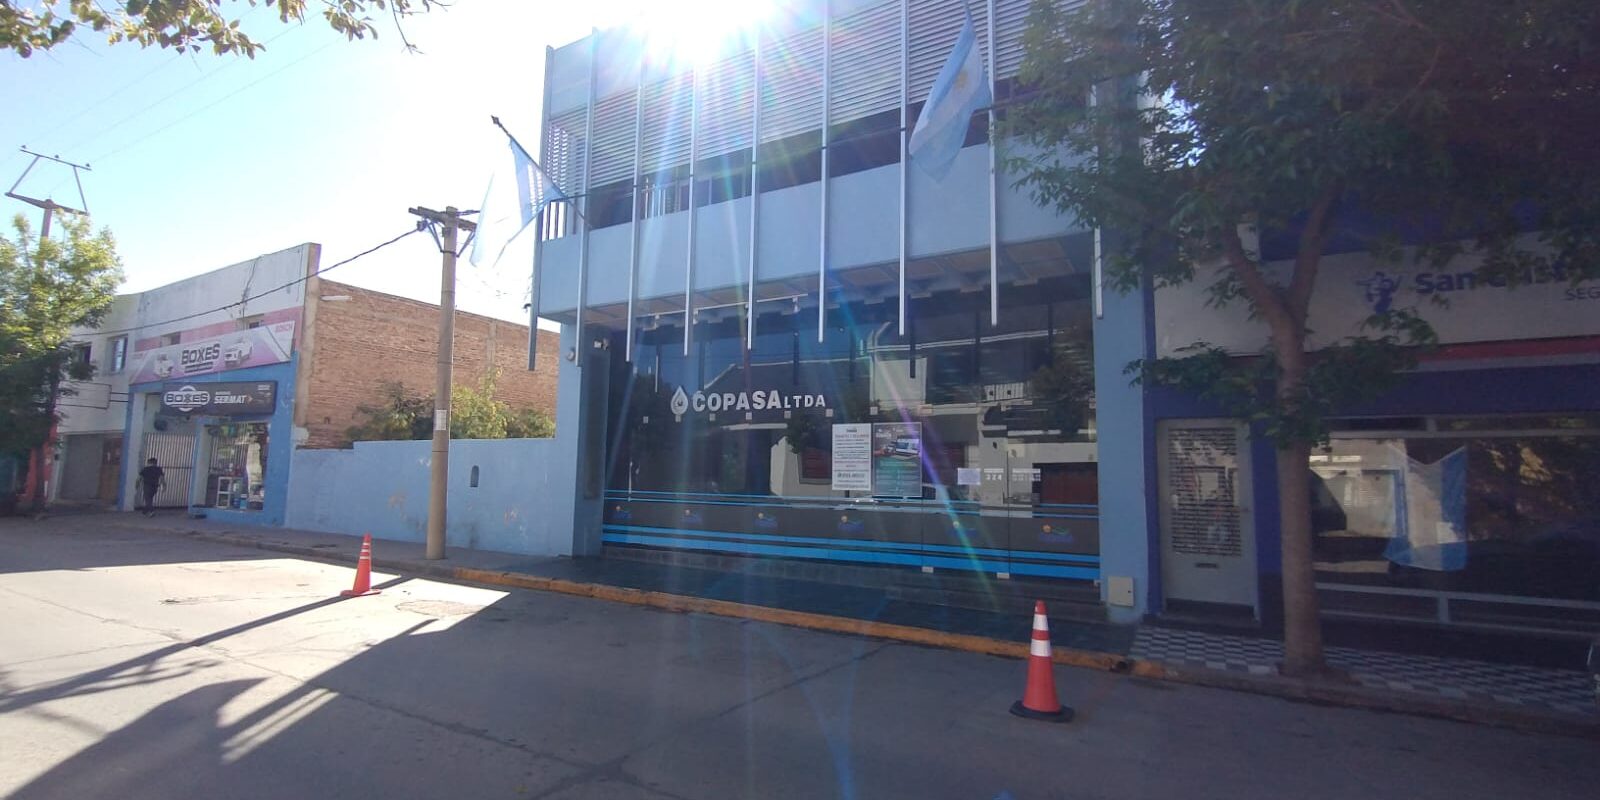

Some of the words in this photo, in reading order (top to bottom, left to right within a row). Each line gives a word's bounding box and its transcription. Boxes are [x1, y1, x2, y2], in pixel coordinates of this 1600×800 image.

[1415, 272, 1476, 294] San
[181, 342, 221, 365] BOXES
[165, 392, 209, 403] BOXES
[692, 390, 782, 412] COPASA
[783, 394, 826, 409] LTDA
